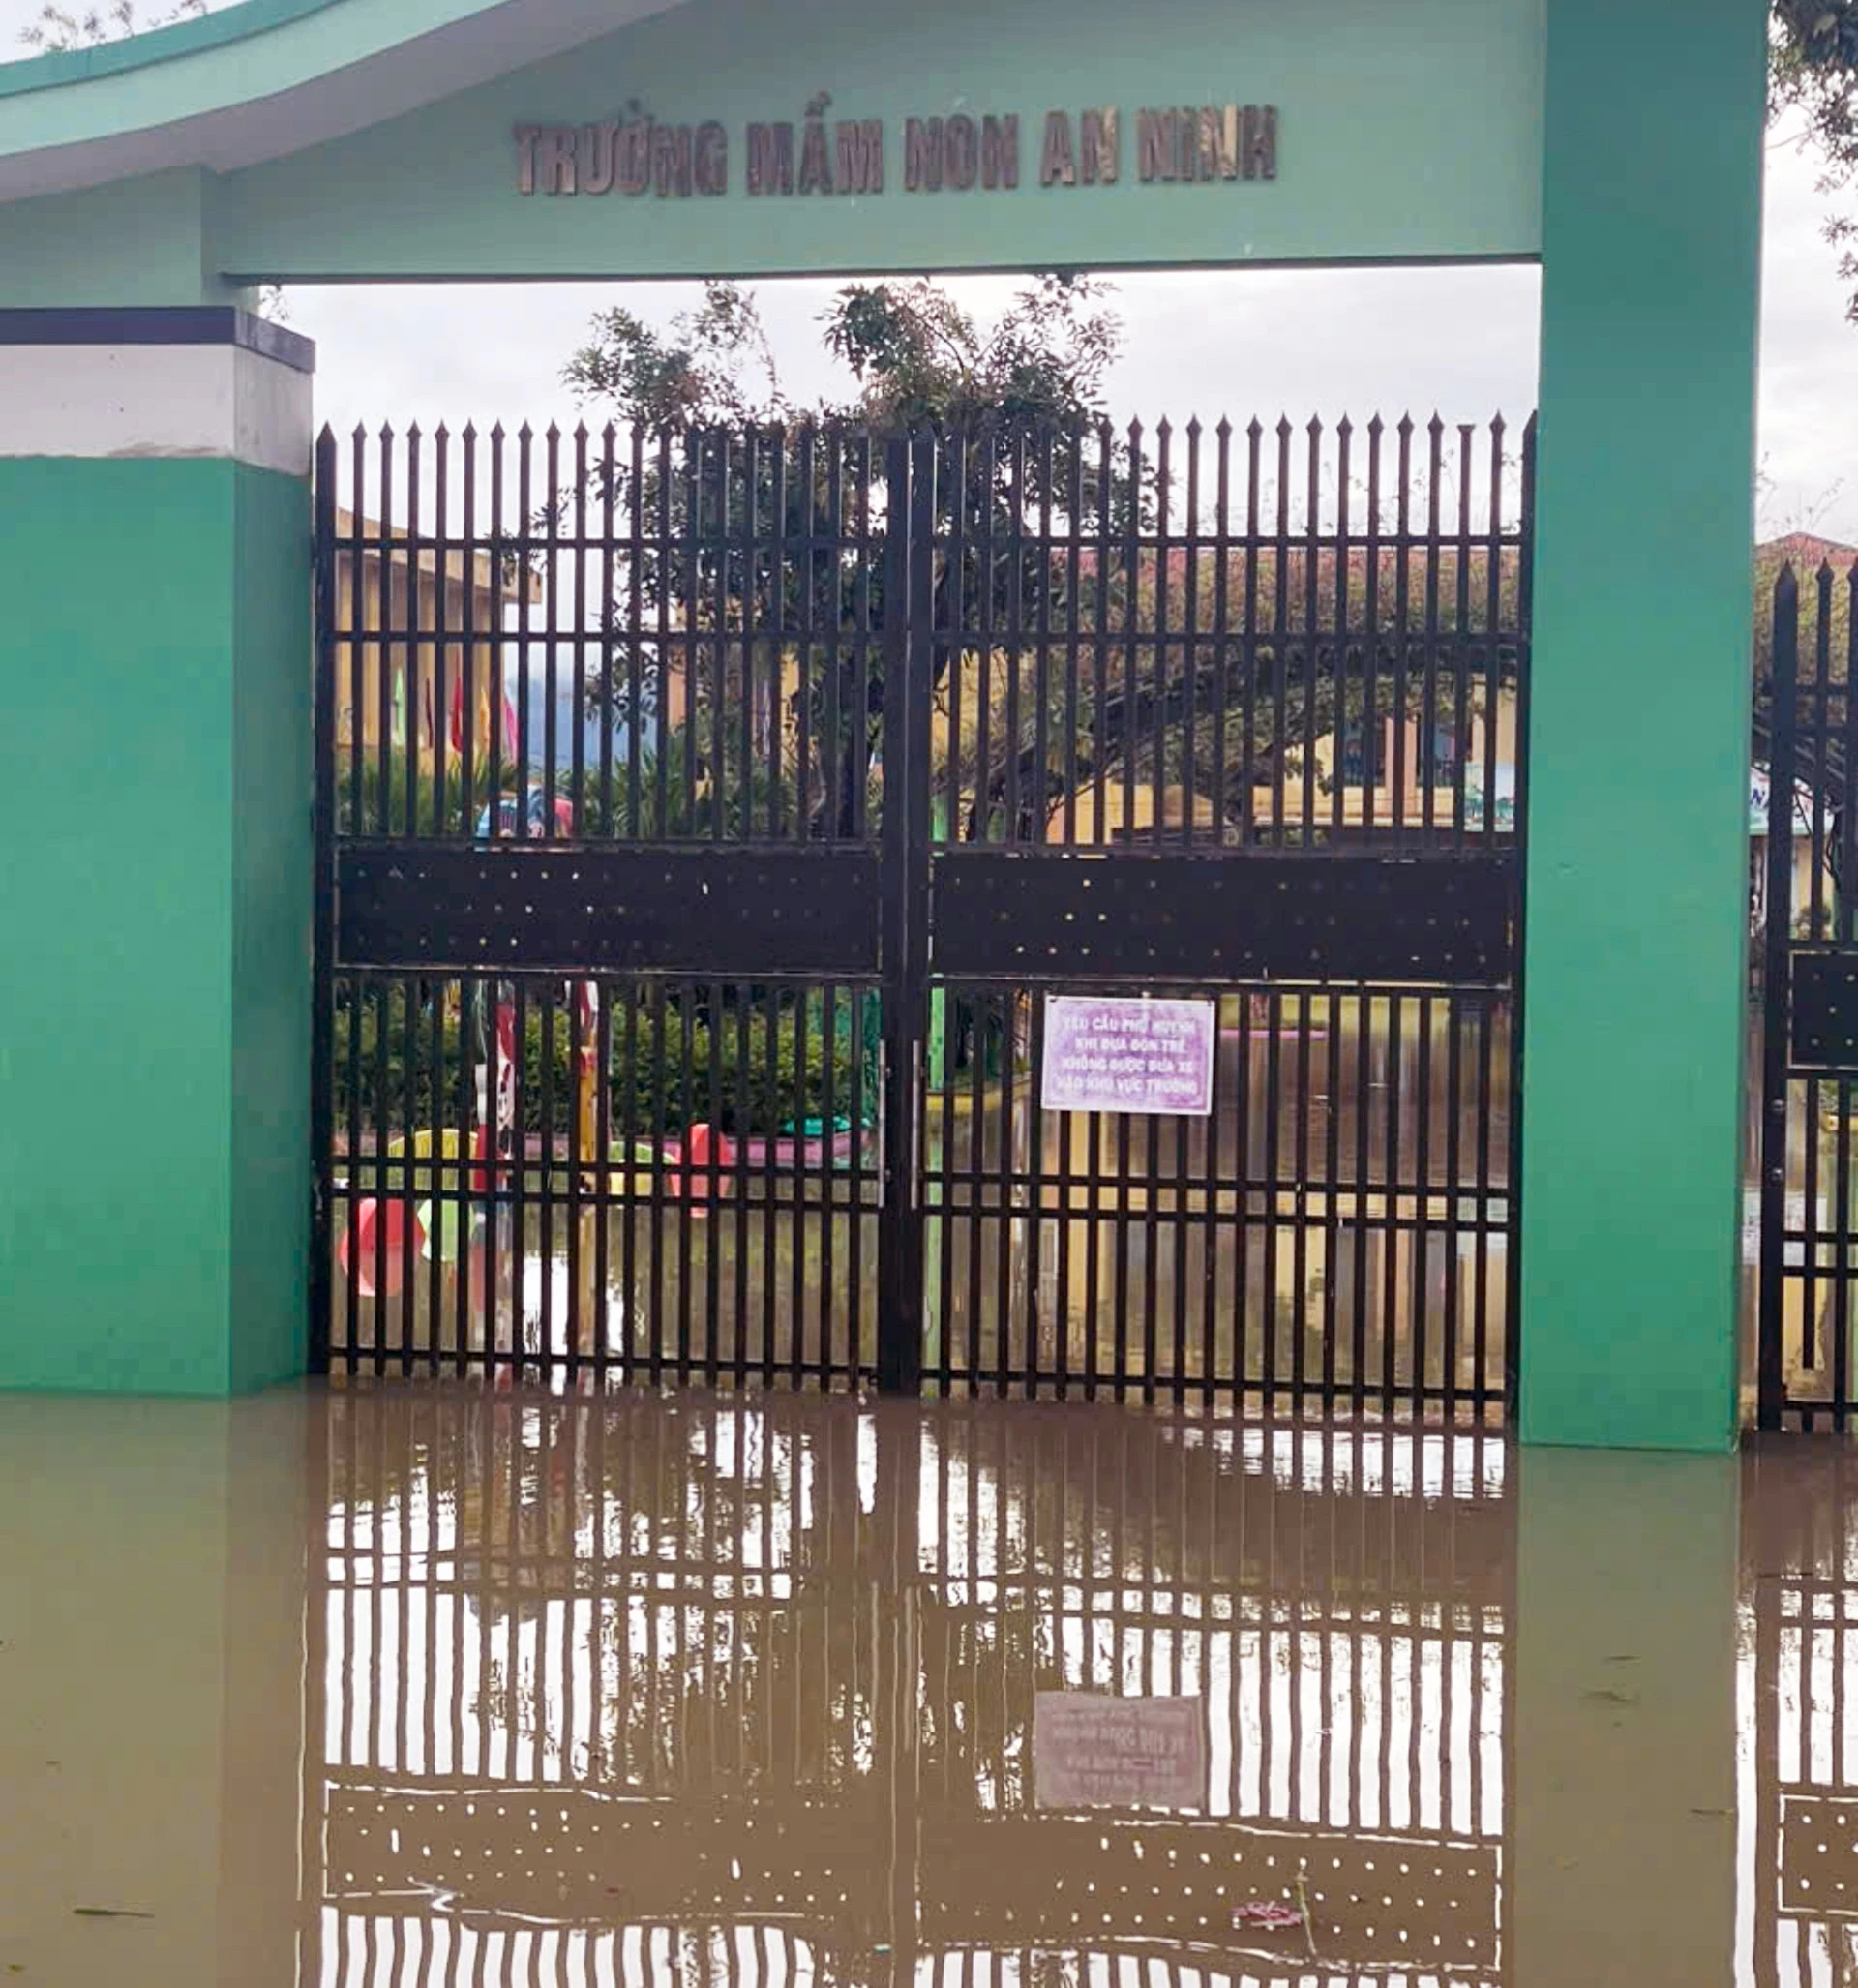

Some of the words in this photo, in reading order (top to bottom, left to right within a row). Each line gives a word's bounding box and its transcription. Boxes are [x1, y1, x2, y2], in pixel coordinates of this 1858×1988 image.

[512, 100, 729, 197] TRƯỜNG
[904, 112, 1019, 192] NON
[1041, 106, 1119, 187] AN
[1139, 103, 1278, 182] NINH
